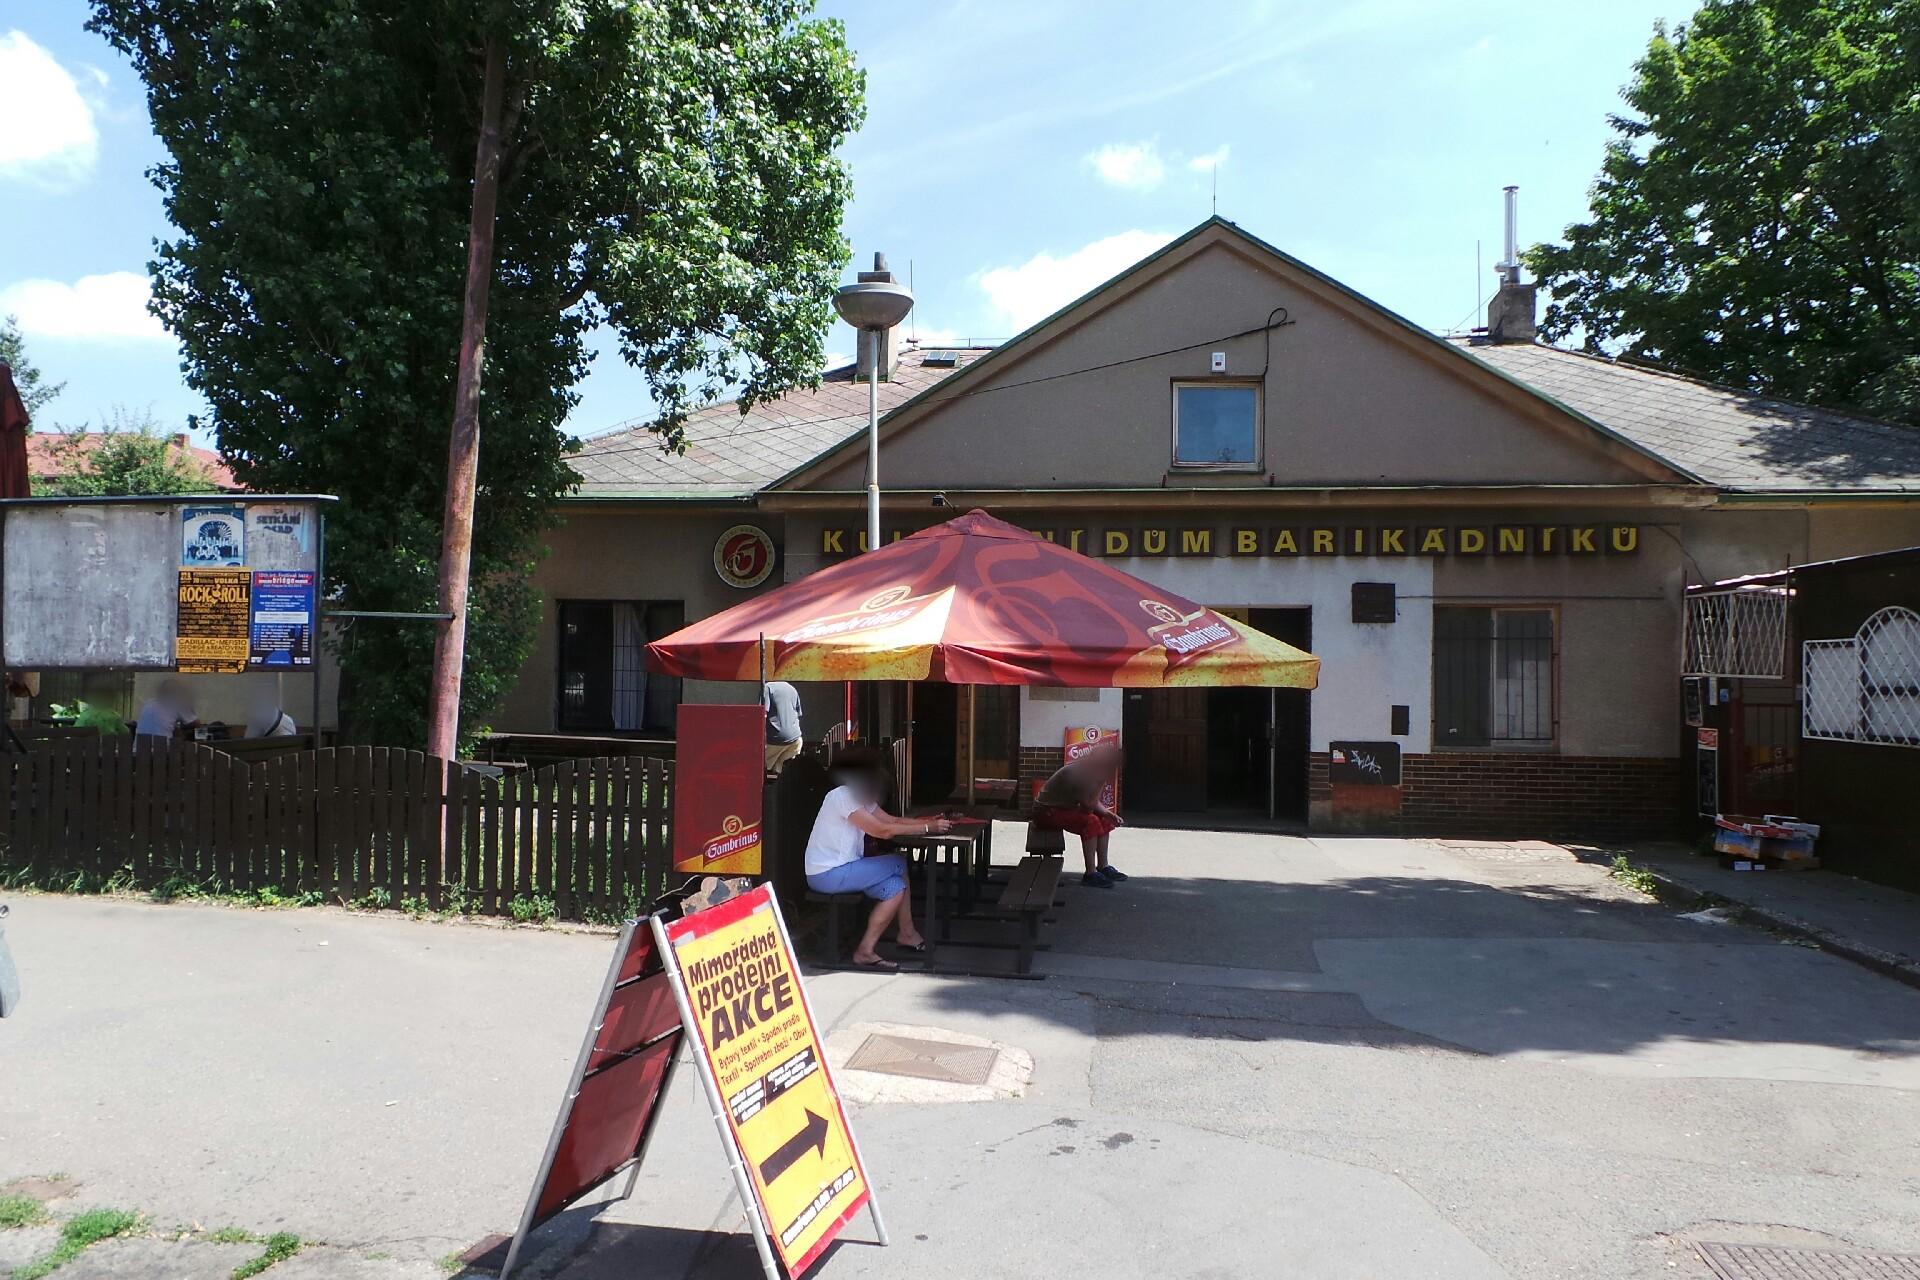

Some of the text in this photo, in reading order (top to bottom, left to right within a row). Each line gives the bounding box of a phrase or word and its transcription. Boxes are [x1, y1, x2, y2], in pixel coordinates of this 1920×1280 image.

[1105, 529, 1211, 554] DŮM
[1236, 527, 1639, 554] BARIKÁDNÍKŮ
[179, 586, 211, 603] ROCK
[220, 587, 249, 603] ROLL
[705, 831, 758, 859] Gambrinus
[687, 925, 777, 988] Mimořádná
[697, 946, 783, 1021] prodejní
[711, 971, 794, 1052] AKCE
[740, 1038, 758, 1056] textil
[720, 1068, 740, 1087] Textil
